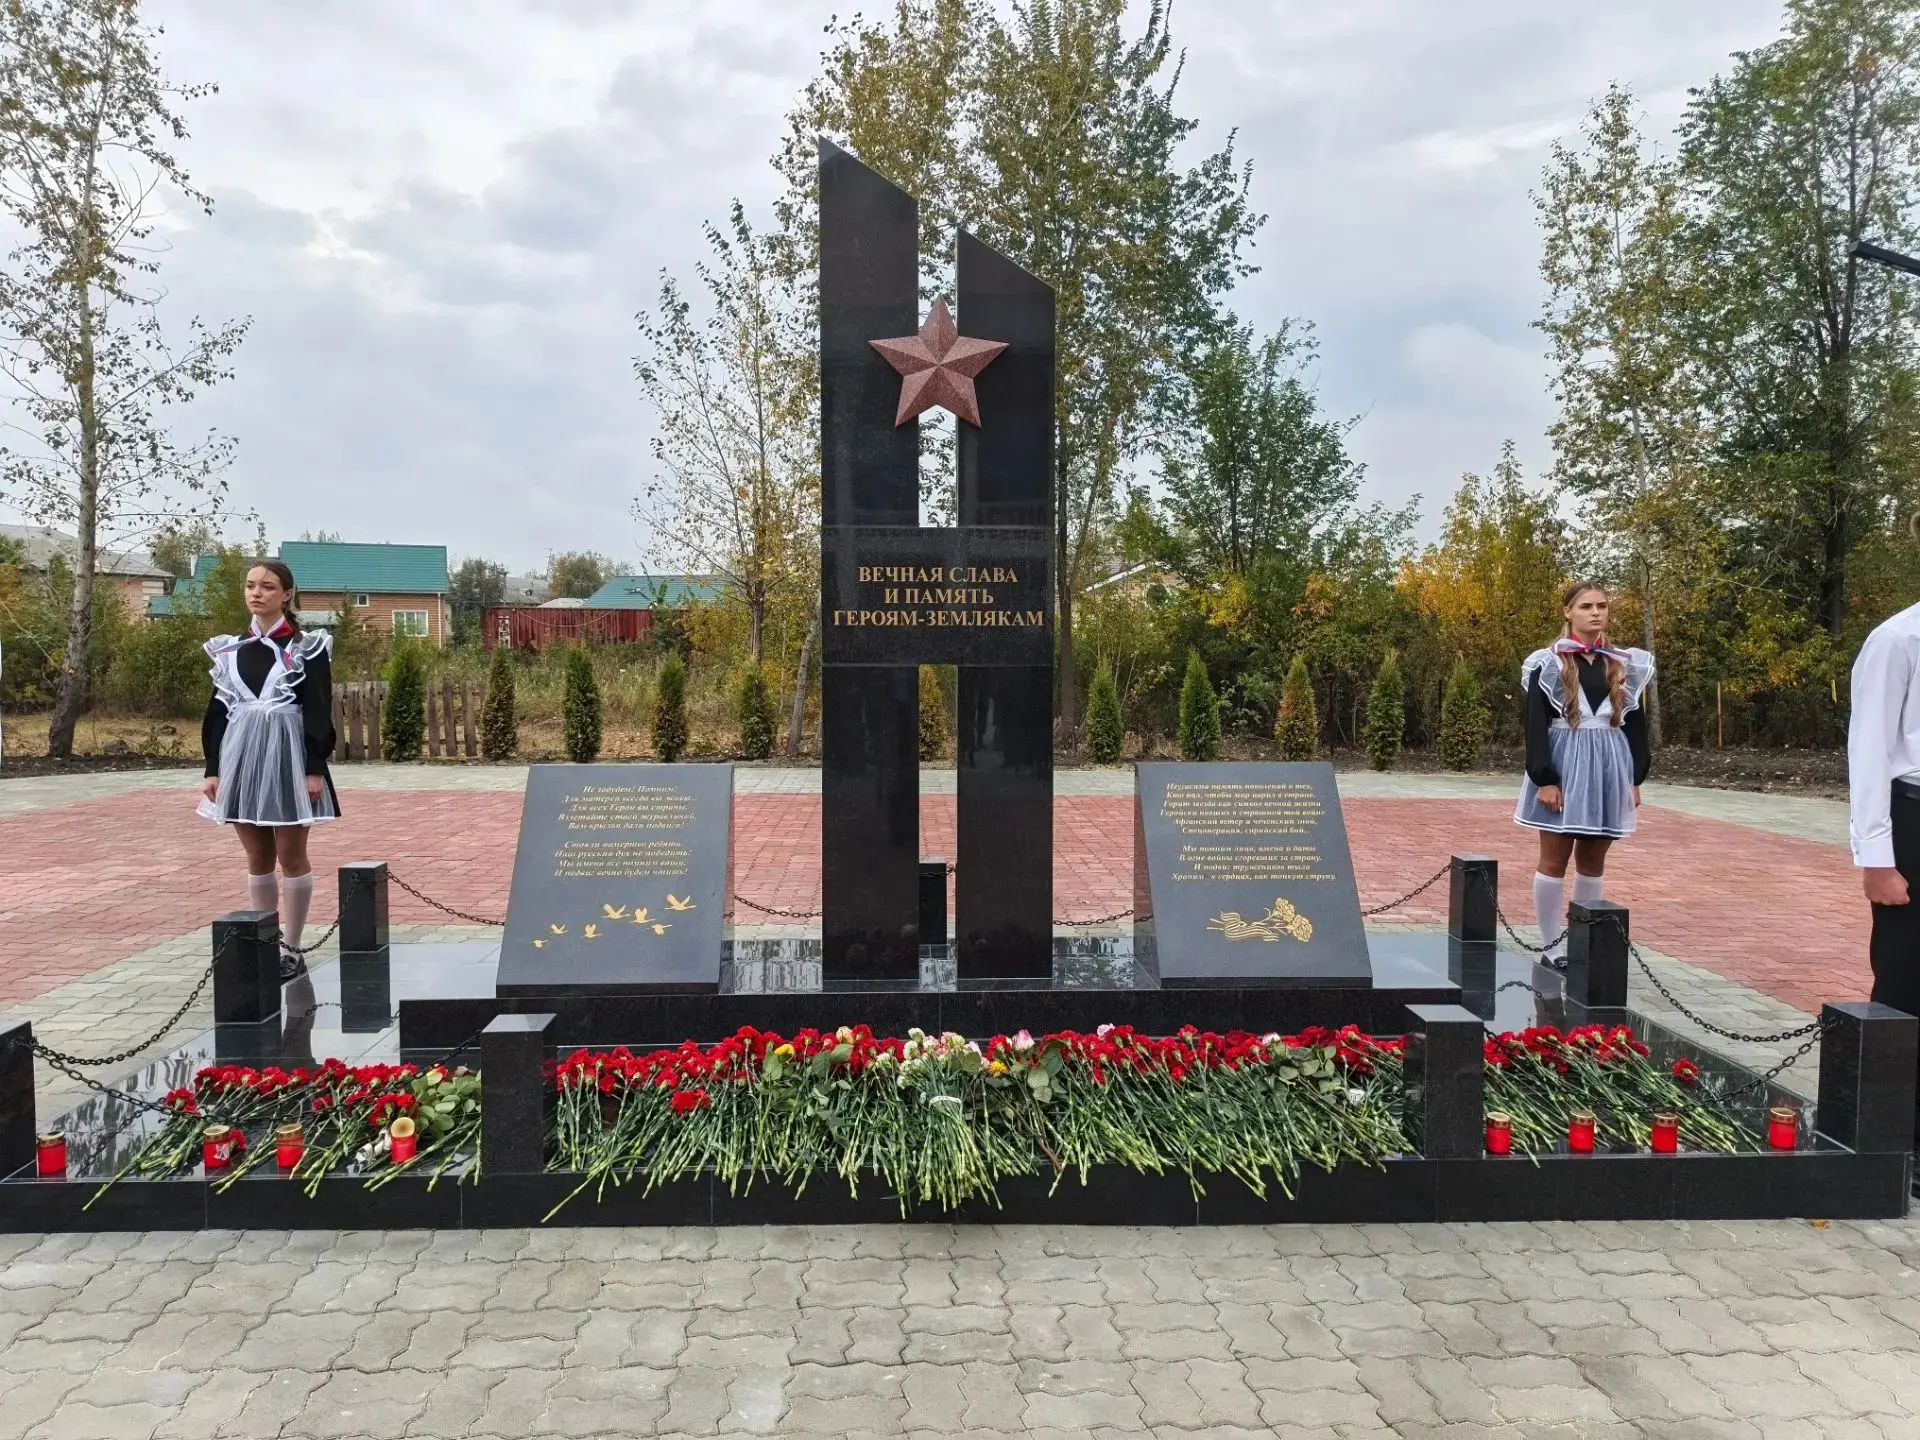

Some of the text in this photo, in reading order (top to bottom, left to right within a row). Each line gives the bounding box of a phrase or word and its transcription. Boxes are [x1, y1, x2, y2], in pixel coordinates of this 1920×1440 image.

[858, 567, 1018, 582] ВЕЧНАЯ СЛАВА
[885, 588, 994, 604] И ПАМЯТЬ
[834, 611, 1044, 626] ГЕРОЯМ-ЗЕМЛЯКАМ
[1173, 818, 1218, 826] Афганский
[1220, 818, 1243, 826] ветер
[555, 850, 577, 858] Наш
[578, 850, 613, 858] русский
[615, 850, 630, 858] дух
[633, 850, 642, 858] не
[1188, 854, 1205, 862] огне
[1208, 854, 1232, 862] войны
[1235, 854, 1278, 862] сгоревших
[1218, 873, 1252, 881] сердцах,
[1254, 873, 1268, 881] как
[1271, 873, 1304, 881] тонкую
